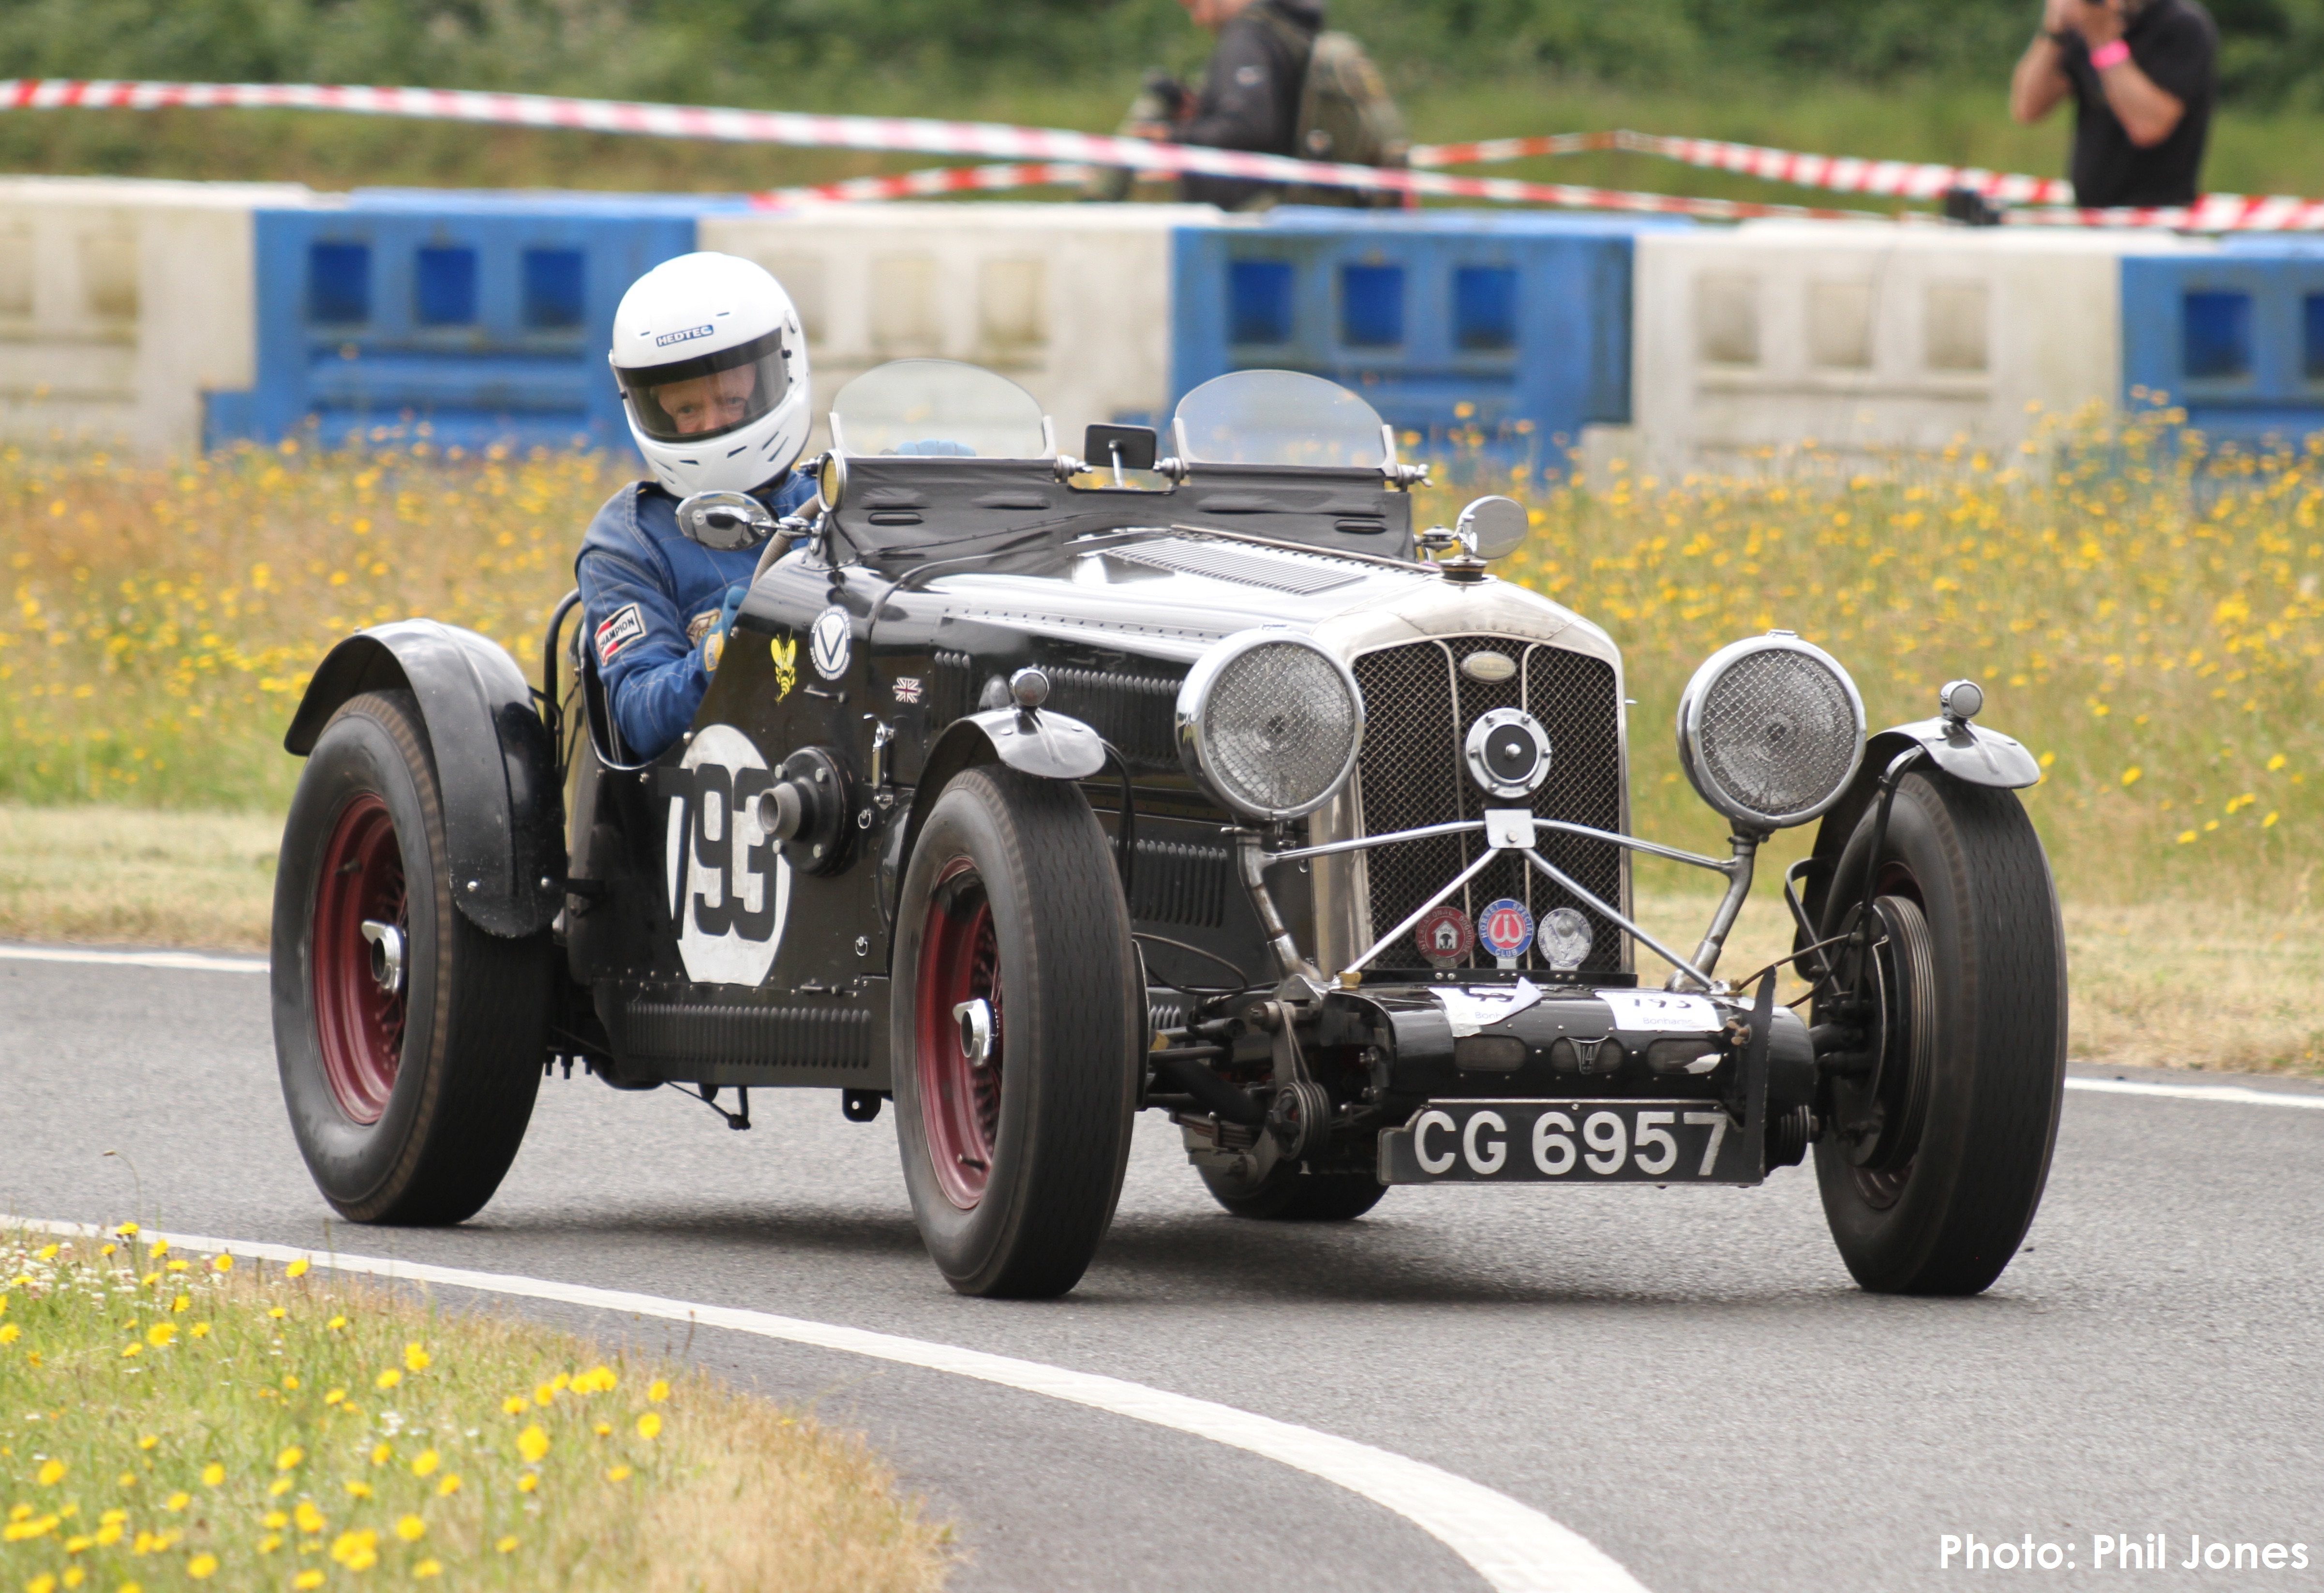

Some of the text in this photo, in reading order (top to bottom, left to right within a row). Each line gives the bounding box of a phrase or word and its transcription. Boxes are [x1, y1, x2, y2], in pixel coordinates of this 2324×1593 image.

[658, 326, 713, 346] HEDTEC
[811, 610, 826, 633] VINTAGE
[658, 763, 776, 942] 793
[1418, 910, 1453, 953] INTERNATONAL
[1459, 916, 1473, 953] DOGHOUSE
[1480, 902, 1499, 939] HORNET
[1512, 903, 1533, 937] SPECIAL
[1495, 948, 1518, 957] CLUB
[1581, 1045, 1595, 1065] 14
[1414, 1110, 1728, 1176] CG 6957
